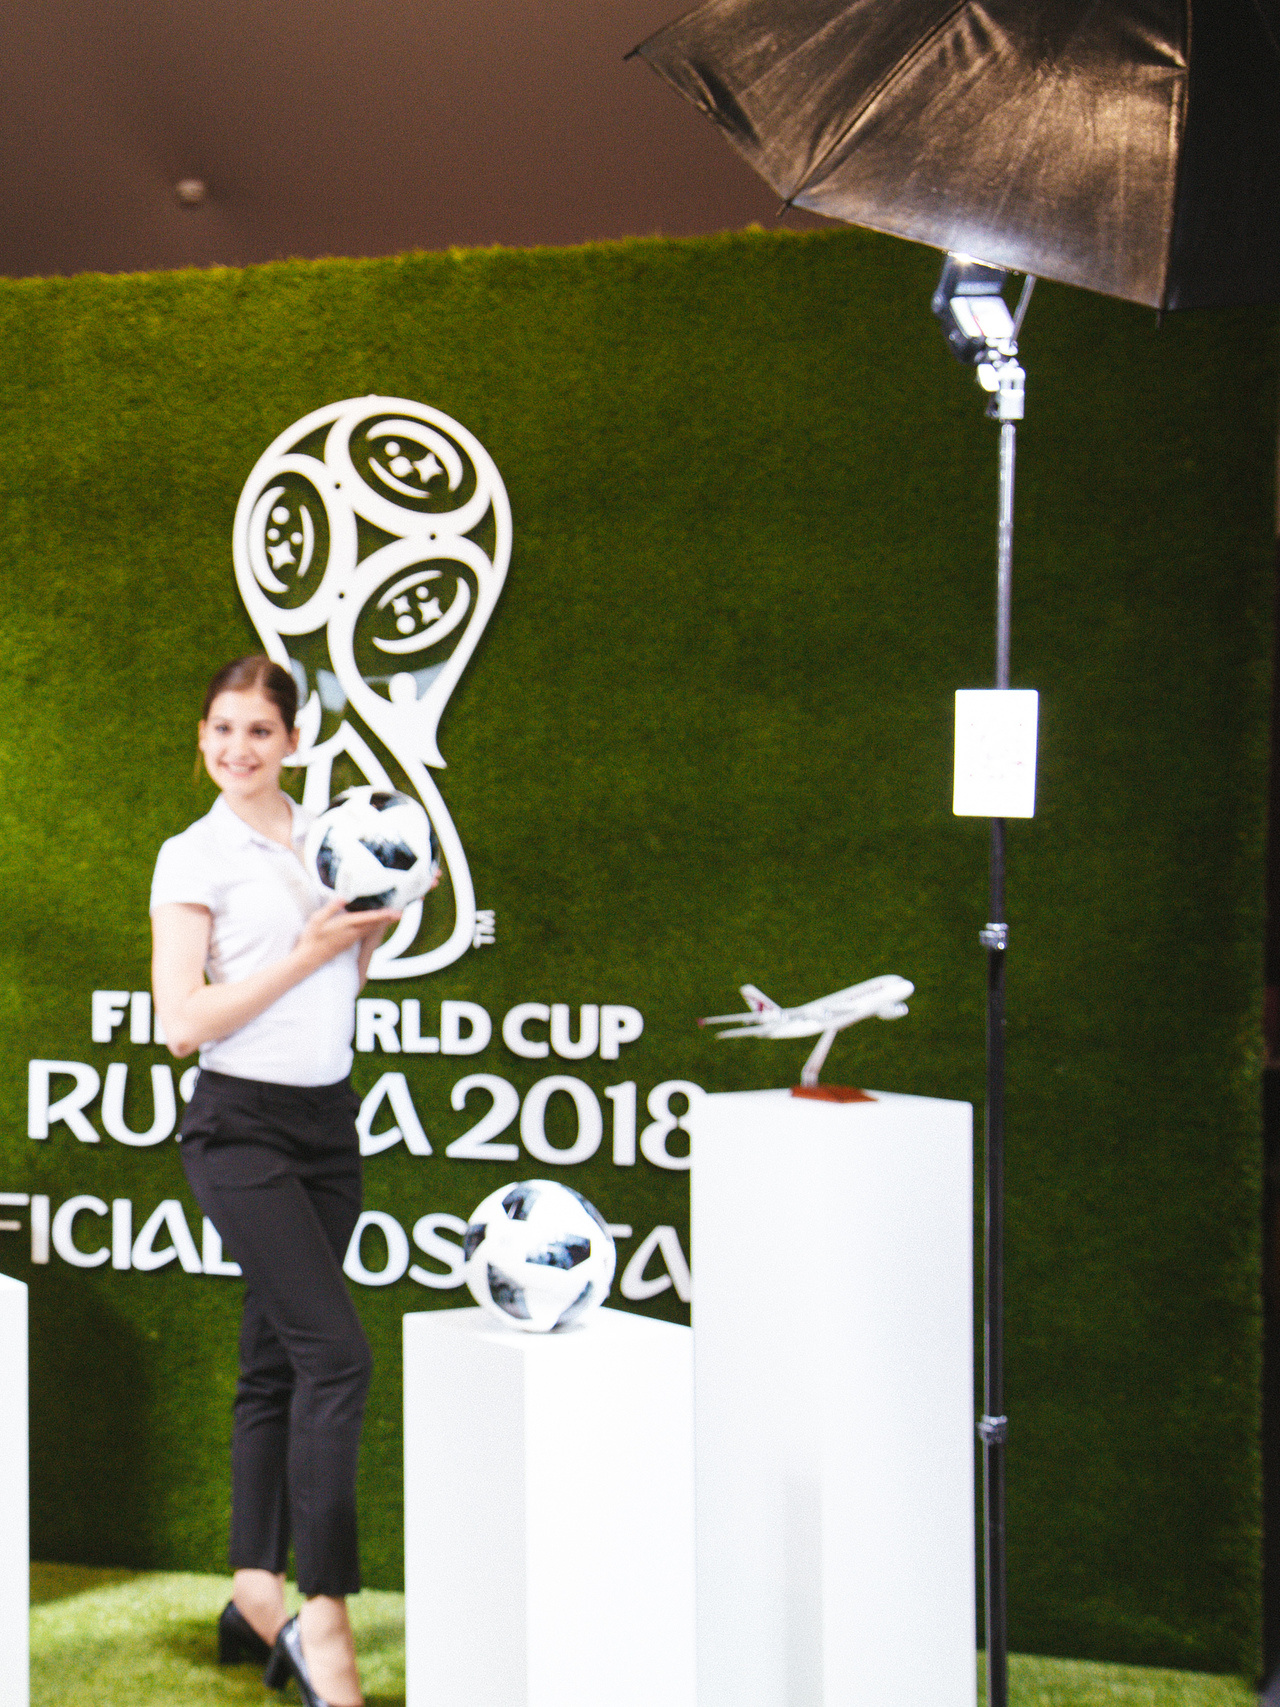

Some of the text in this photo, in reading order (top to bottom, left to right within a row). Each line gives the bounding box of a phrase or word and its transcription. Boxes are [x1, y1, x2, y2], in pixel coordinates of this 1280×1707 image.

[91, 989, 644, 1060] FI RLD CUP
[446, 1073, 705, 1170] 2018
